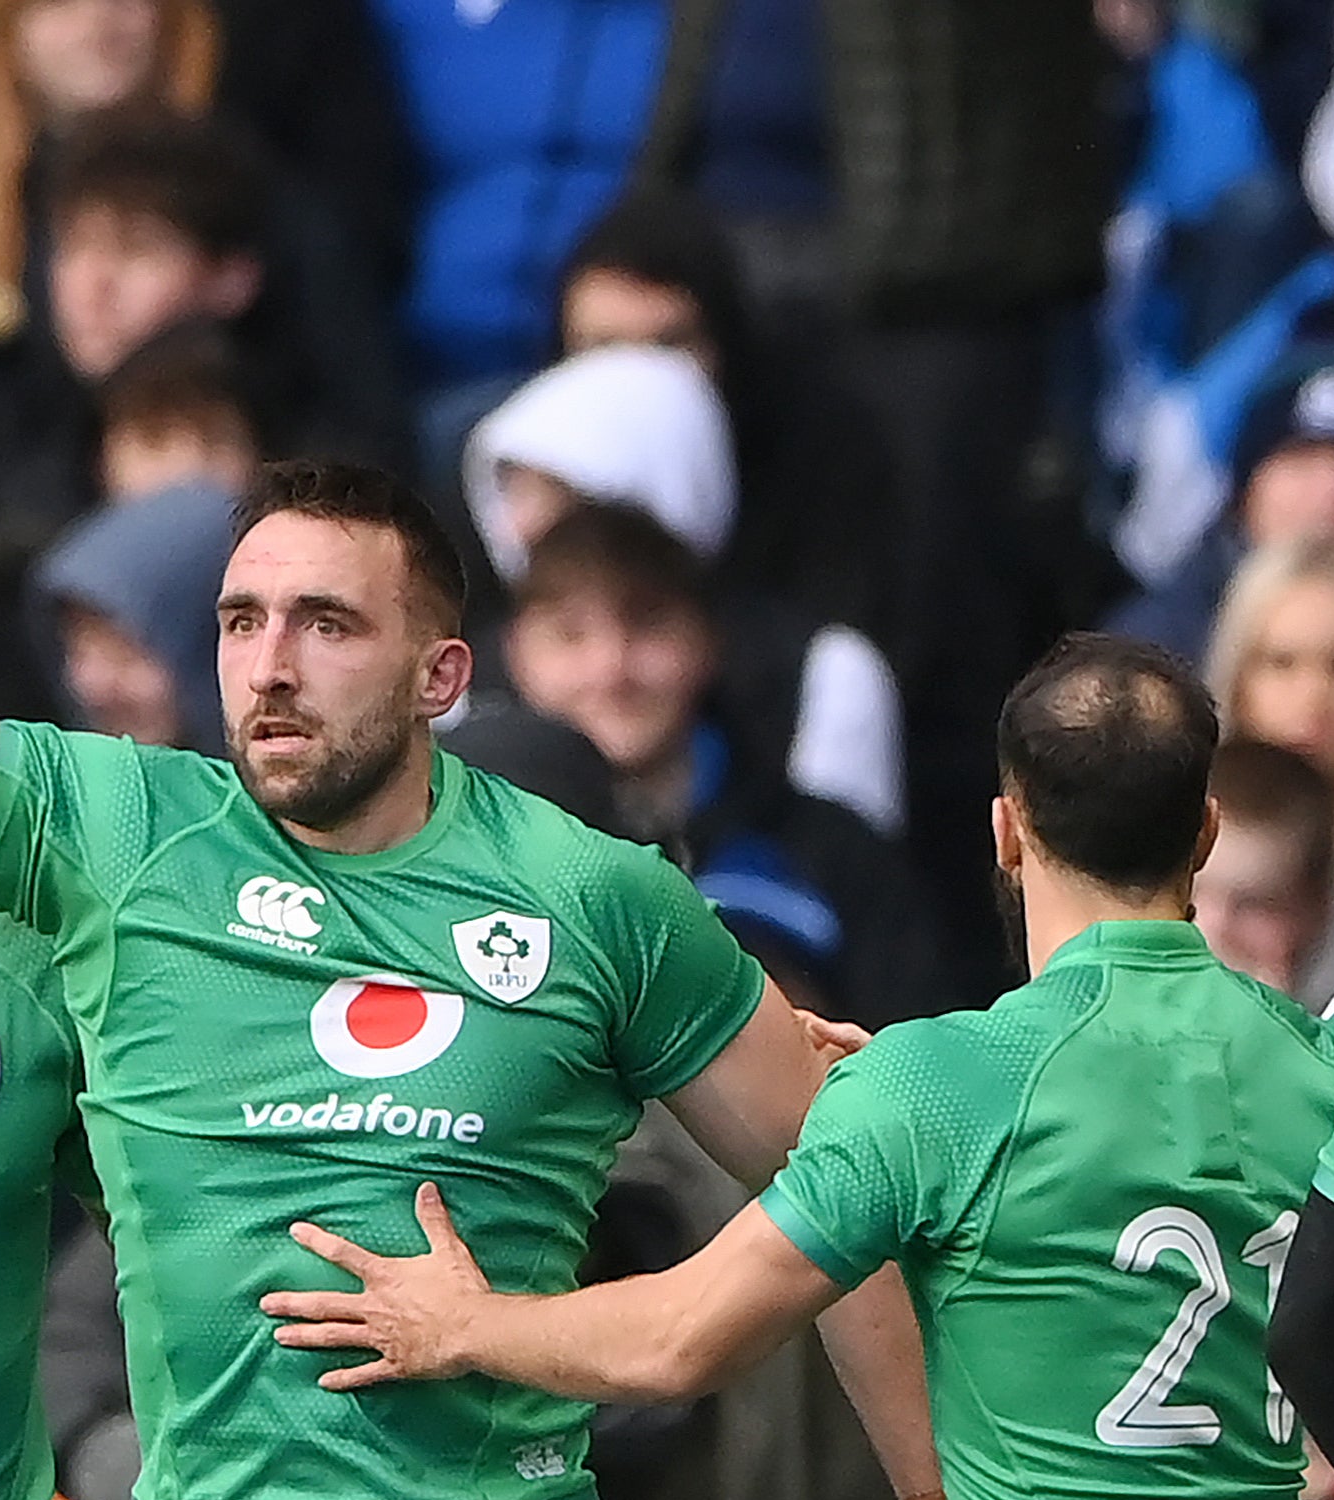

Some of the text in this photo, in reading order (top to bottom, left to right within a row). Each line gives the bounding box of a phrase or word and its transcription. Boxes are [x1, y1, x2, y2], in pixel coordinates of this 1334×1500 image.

[226, 922, 318, 956] canterbury
[488, 974, 528, 988] IRFU
[241, 1092, 485, 1144] vodafone
[1095, 1206, 1301, 1446] 21
